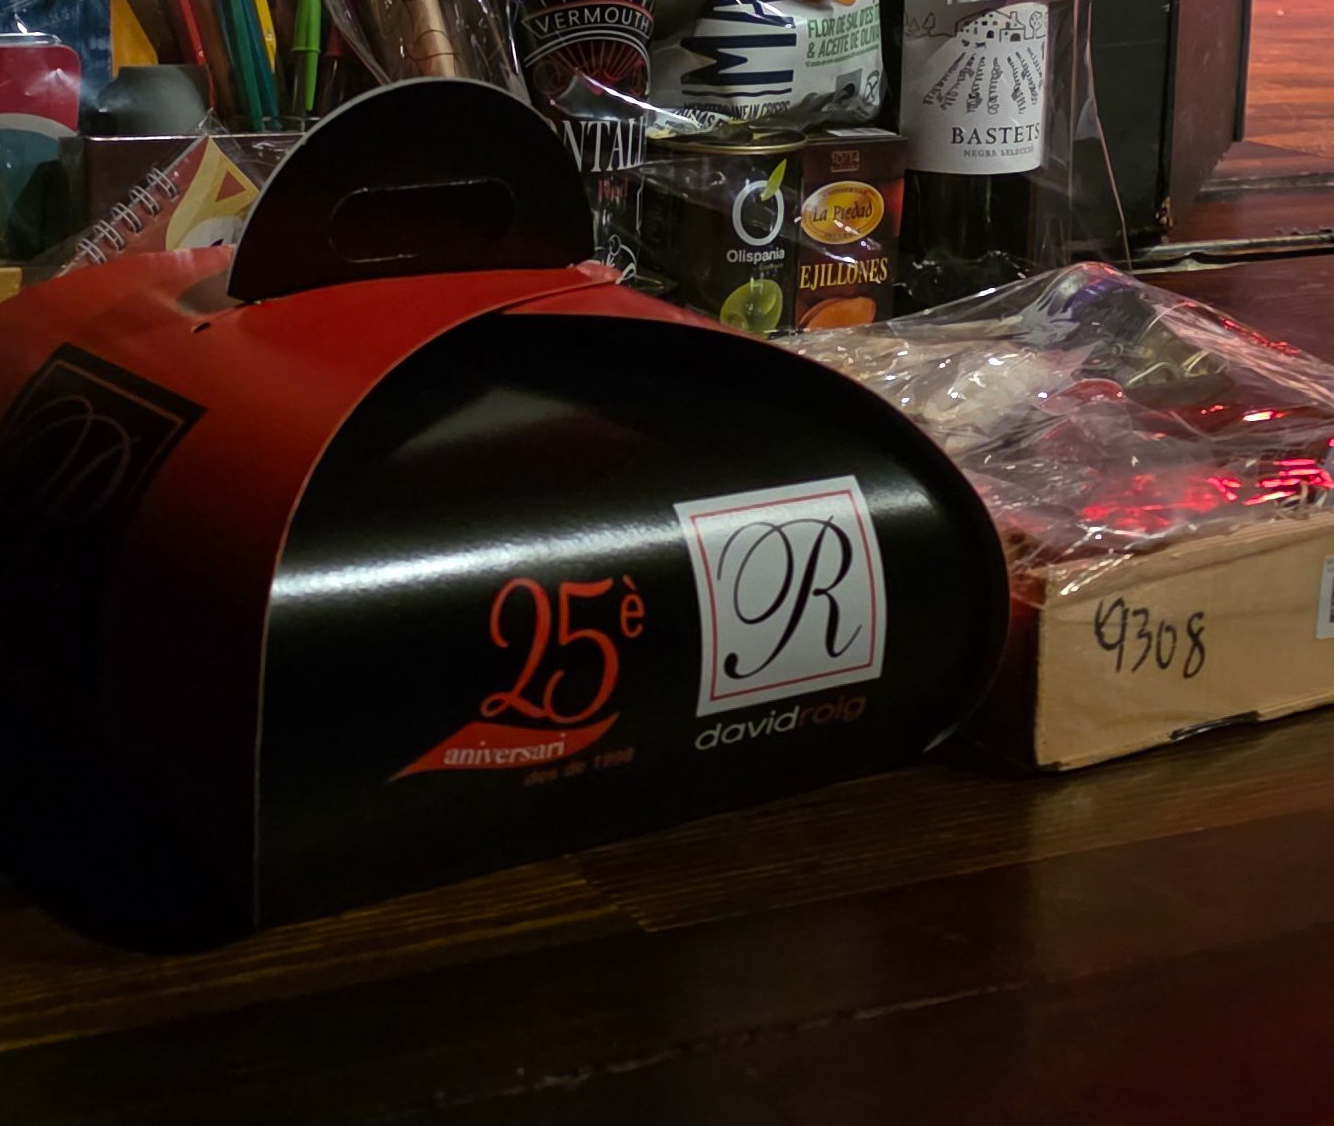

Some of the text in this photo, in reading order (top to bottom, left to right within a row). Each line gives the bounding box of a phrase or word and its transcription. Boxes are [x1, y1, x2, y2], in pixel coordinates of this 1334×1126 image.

[535, 6, 650, 34] VERMOUTH
[807, 18, 835, 38] FLOR
[835, 14, 846, 35] DE
[847, 11, 858, 31] SAL
[806, 41, 815, 59] &
[817, 34, 849, 59] ACEITE
[849, 30, 859, 51] DE
[950, 123, 1040, 145] BASTETS
[812, 200, 873, 223] La Piedad
[726, 247, 785, 265] Olispania
[798, 256, 889, 291] EJILLONES
[716, 514, 862, 679] R
[1094, 596, 1206, 679] 9308
[443, 731, 566, 766] aniversari
